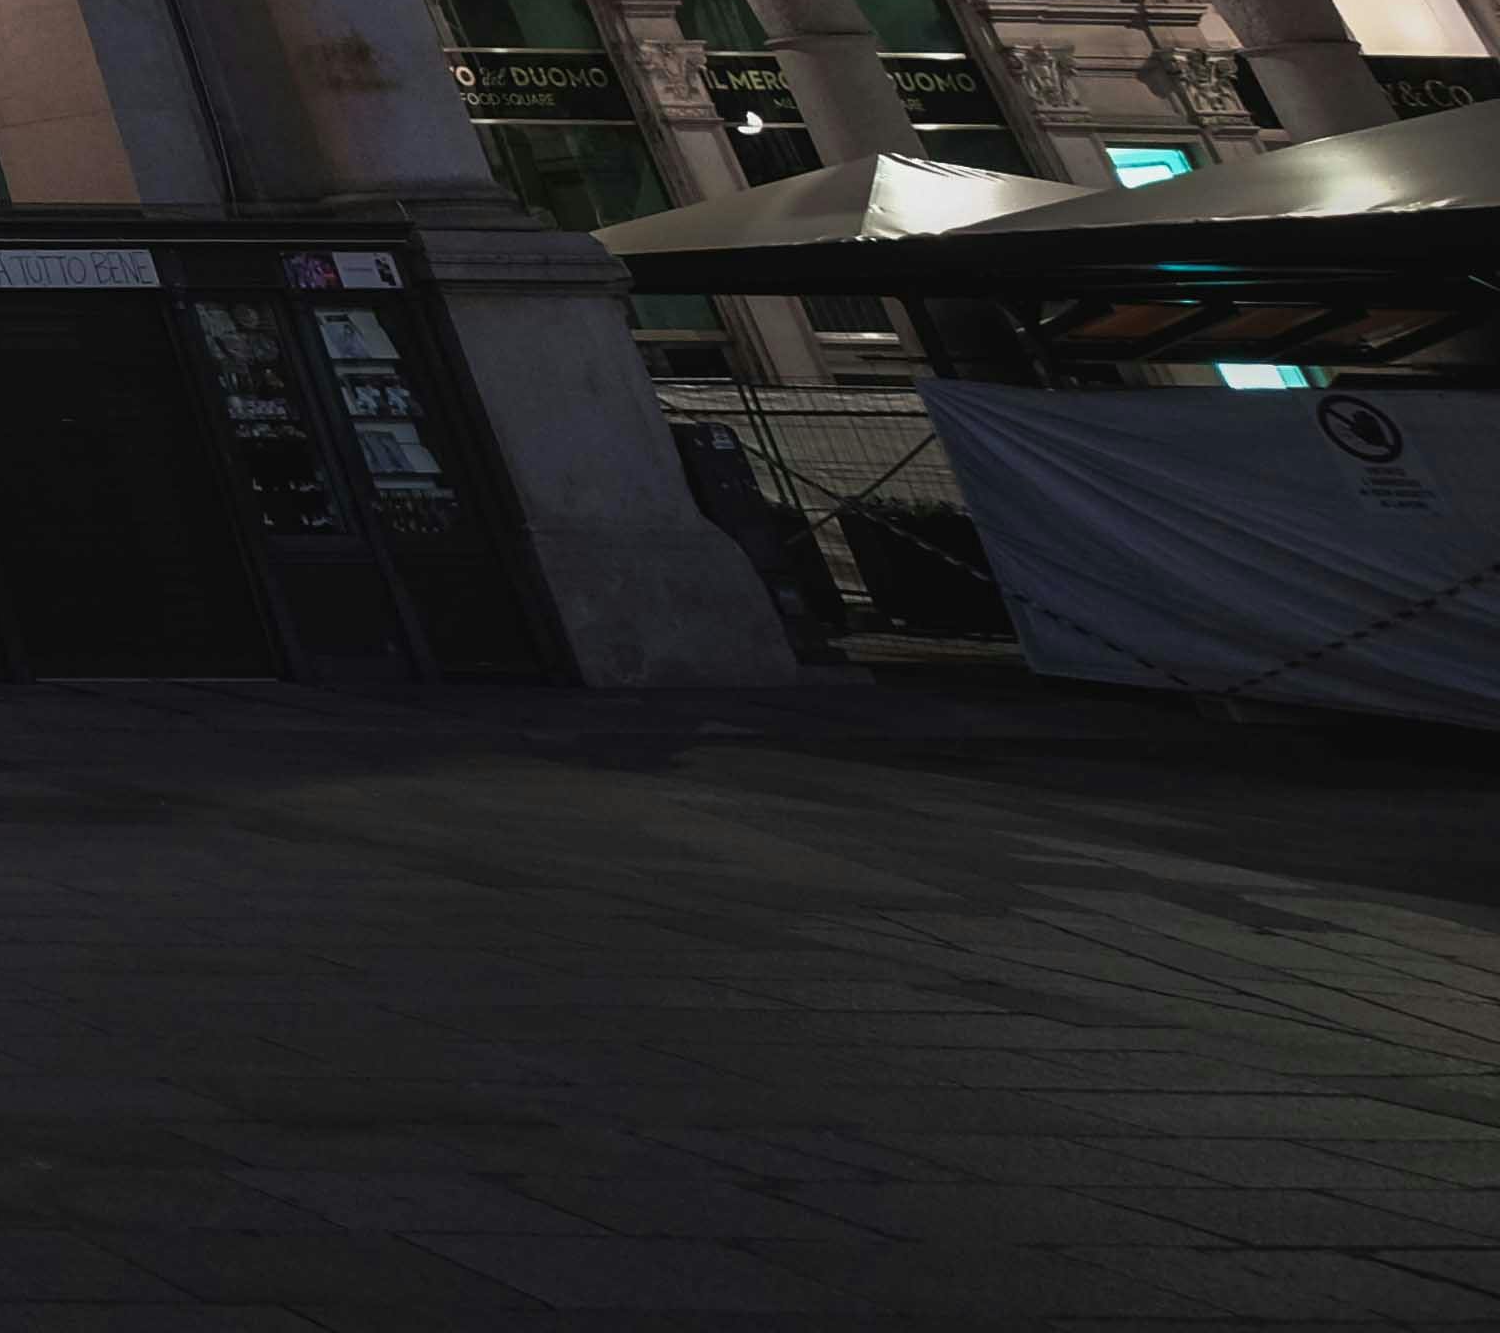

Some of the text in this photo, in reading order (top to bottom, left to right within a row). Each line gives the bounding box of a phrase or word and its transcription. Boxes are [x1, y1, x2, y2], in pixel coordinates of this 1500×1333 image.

[508, 66, 608, 88] DUOMO
[700, 65, 729, 89] IL
[885, 72, 977, 93] UOMO
[502, 92, 557, 107] SQUARE
[9, 254, 87, 286] TUTTO
[91, 251, 154, 286] BENE
